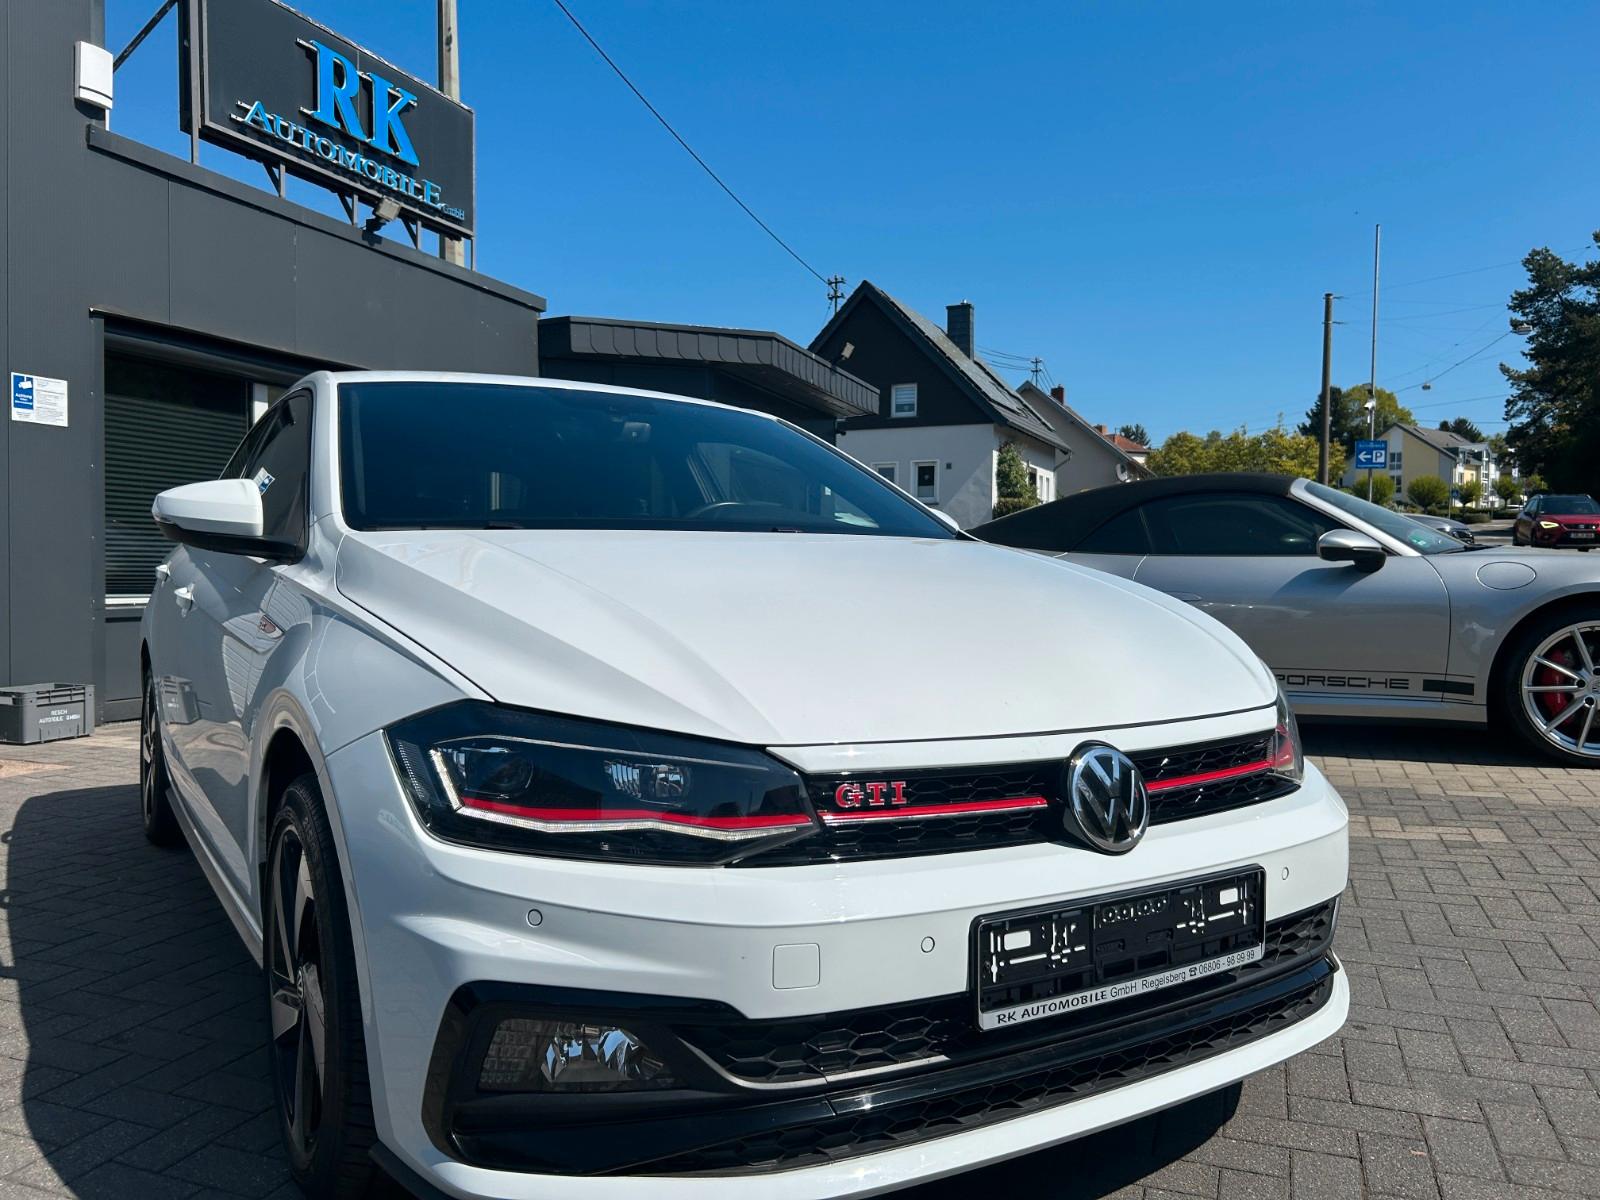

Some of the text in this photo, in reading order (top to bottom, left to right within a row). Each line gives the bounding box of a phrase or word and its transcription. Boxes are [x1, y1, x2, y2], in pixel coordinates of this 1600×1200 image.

[297, 38, 420, 167] RK
[231, 100, 442, 208] AUTOMOBILE
[1374, 451, 1383, 462] P
[835, 781, 907, 808] GTI
[997, 1010, 1017, 1024] RK
[1021, 990, 1108, 1019] AUTOMOBILE
[1110, 981, 1137, 998] GmbH
[1141, 970, 1186, 990] Riegelsberg
[1199, 960, 1221, 975] 06806
[1227, 956, 1236, 966] 98
[1236, 953, 1245, 964] 99
[1246, 949, 1255, 960] 99
